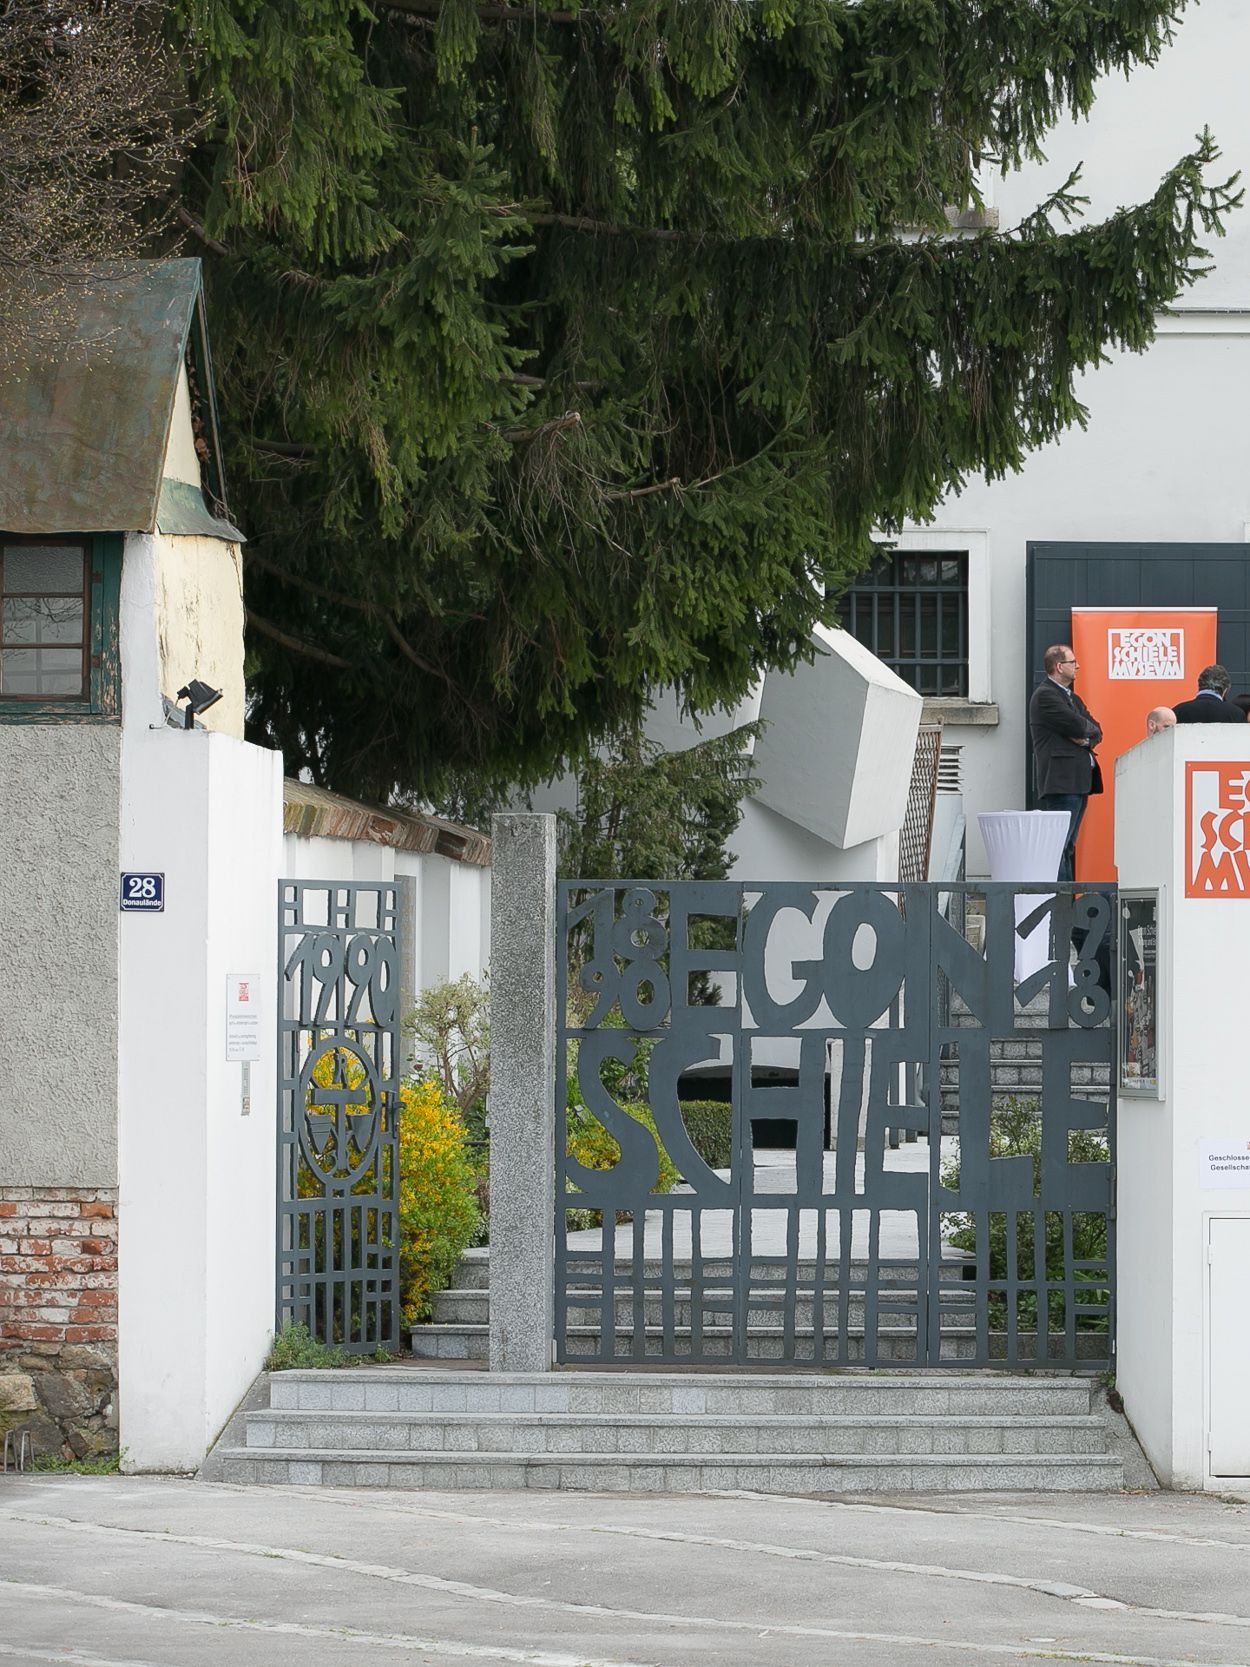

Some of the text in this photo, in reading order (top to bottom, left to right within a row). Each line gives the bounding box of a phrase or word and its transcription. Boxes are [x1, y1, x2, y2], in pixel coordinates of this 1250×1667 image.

[1113, 646, 1178, 661] SCHIELE
[1120, 631, 1171, 647] EGON
[128, 877, 156, 898] 28
[284, 931, 399, 1028] 1990
[669, 886, 1014, 1030] EGON
[565, 1034, 1114, 1196] SCHIELE
